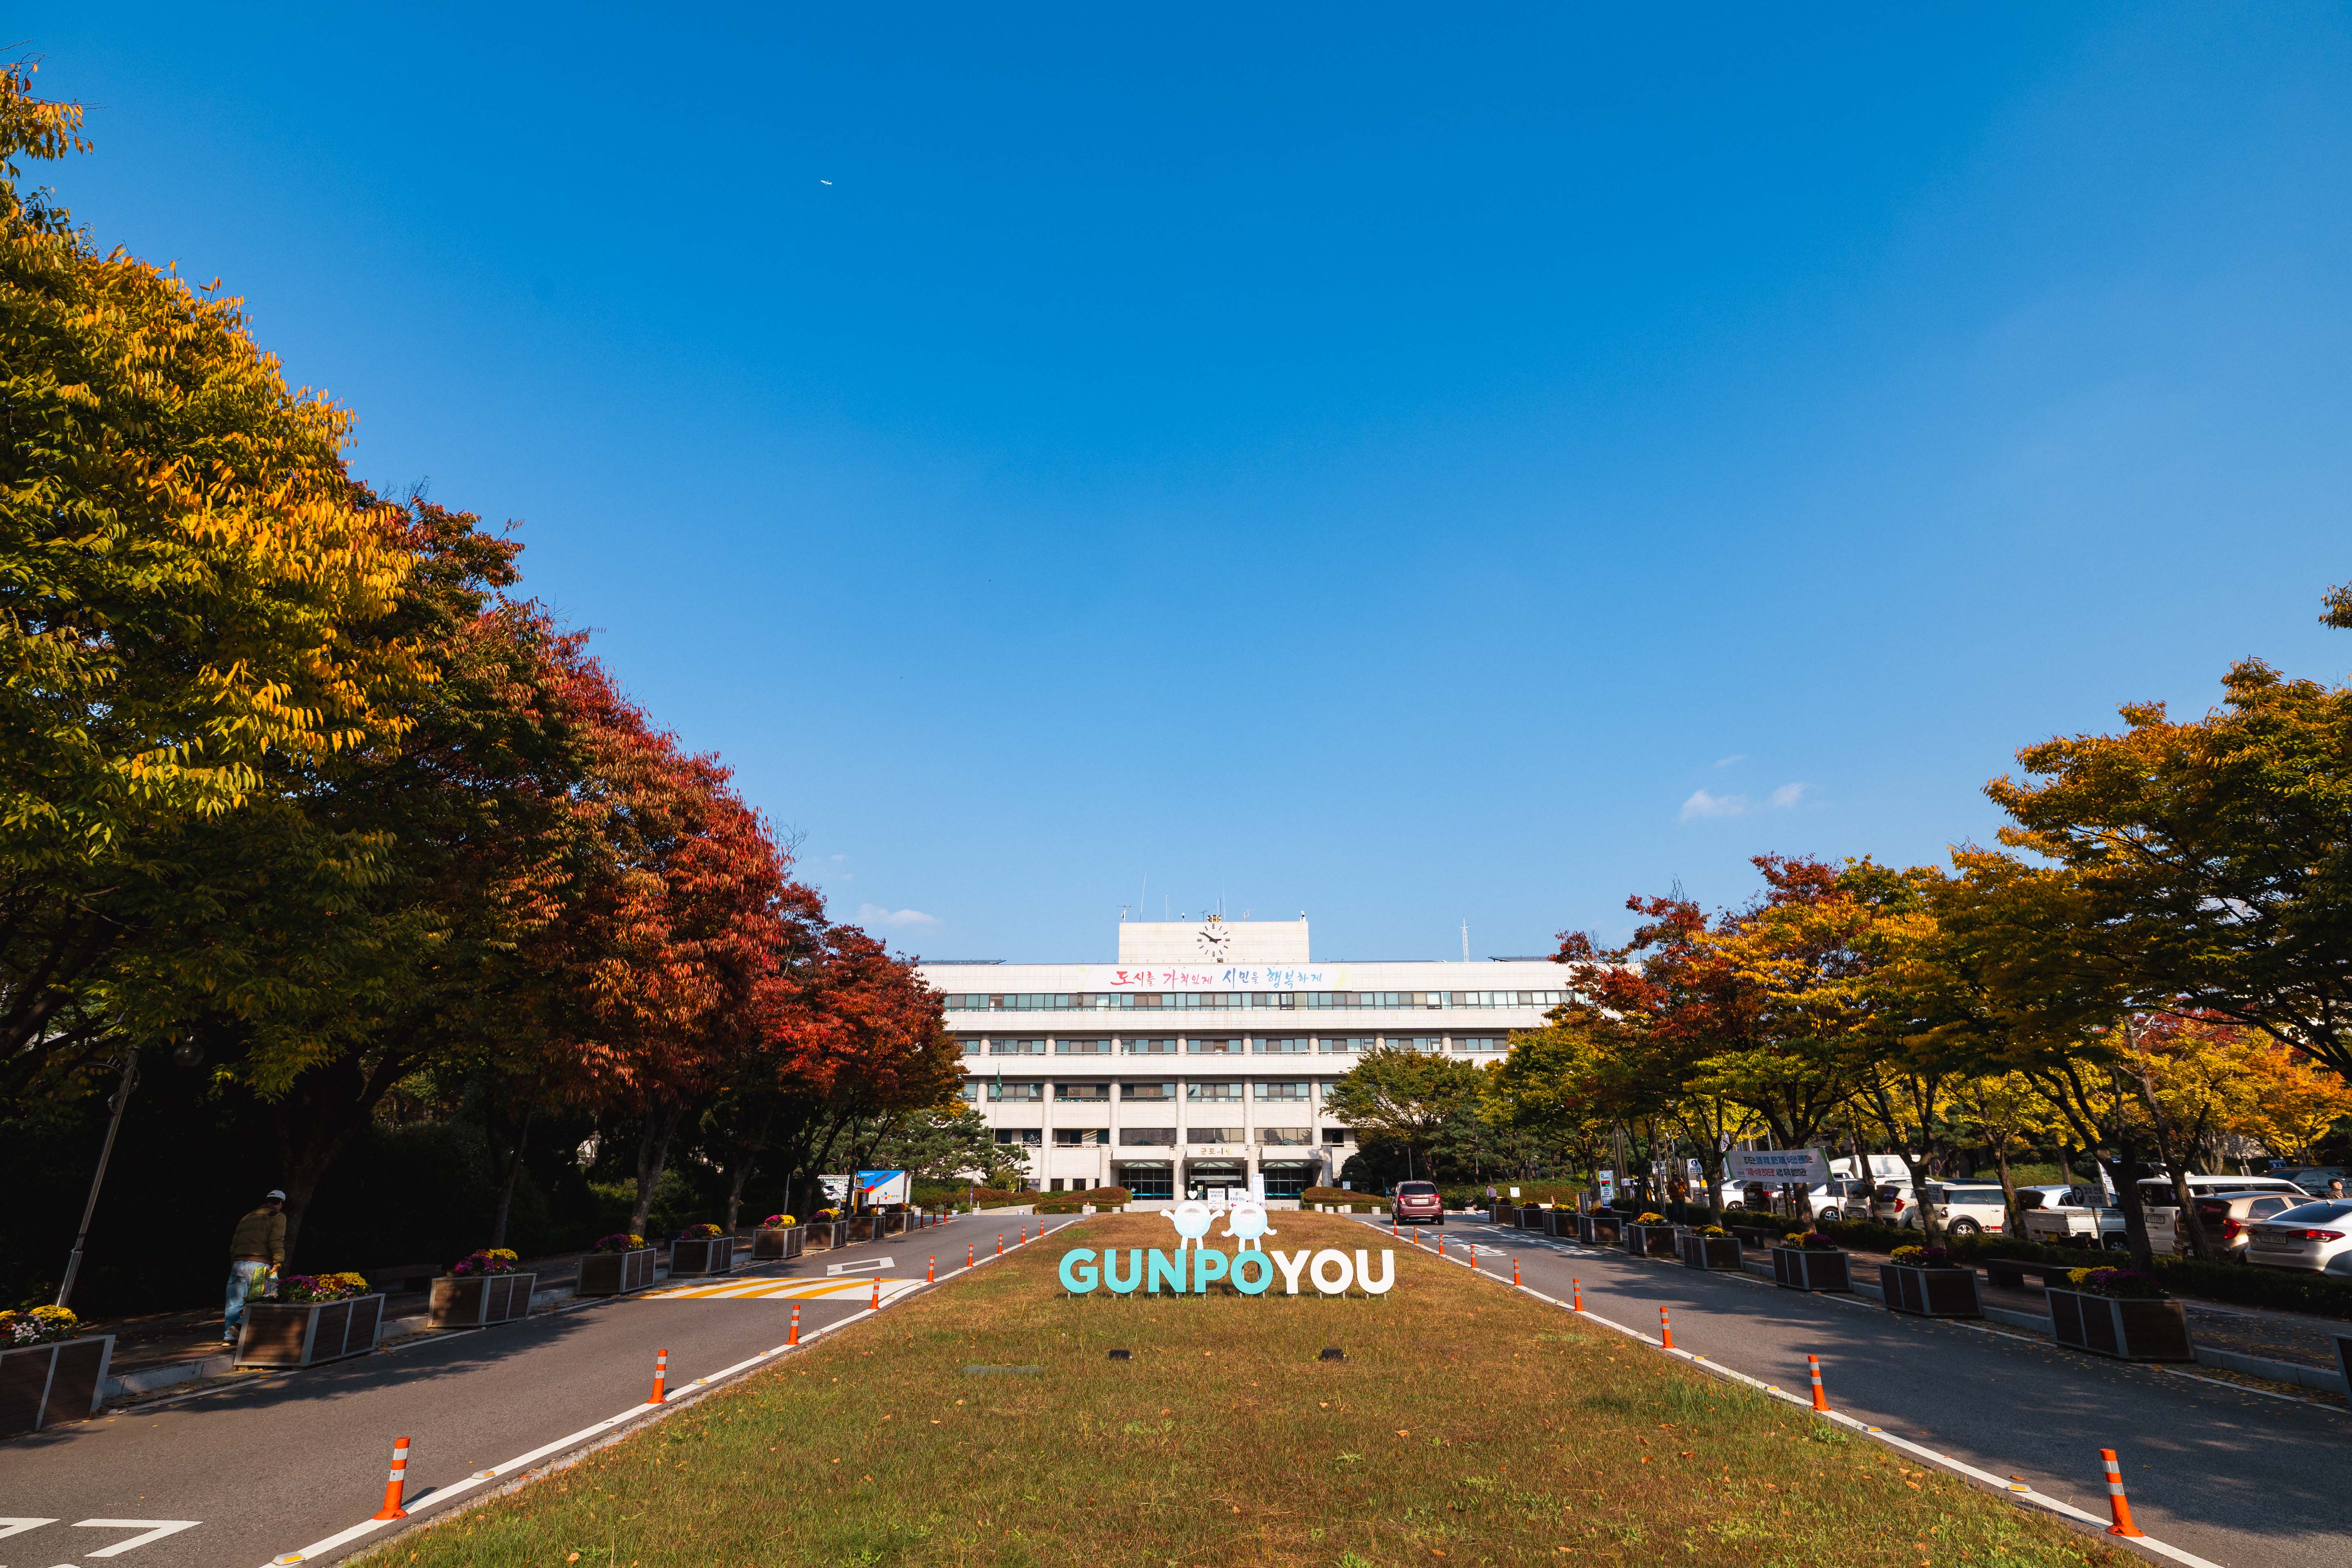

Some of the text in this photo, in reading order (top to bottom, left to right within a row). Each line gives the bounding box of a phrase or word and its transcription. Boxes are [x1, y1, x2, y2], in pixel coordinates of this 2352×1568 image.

[1110, 967, 1322, 990] 도시를 가치있게 시민을 행복하게
[1059, 1248, 1394, 1295] GUNPOYOU
